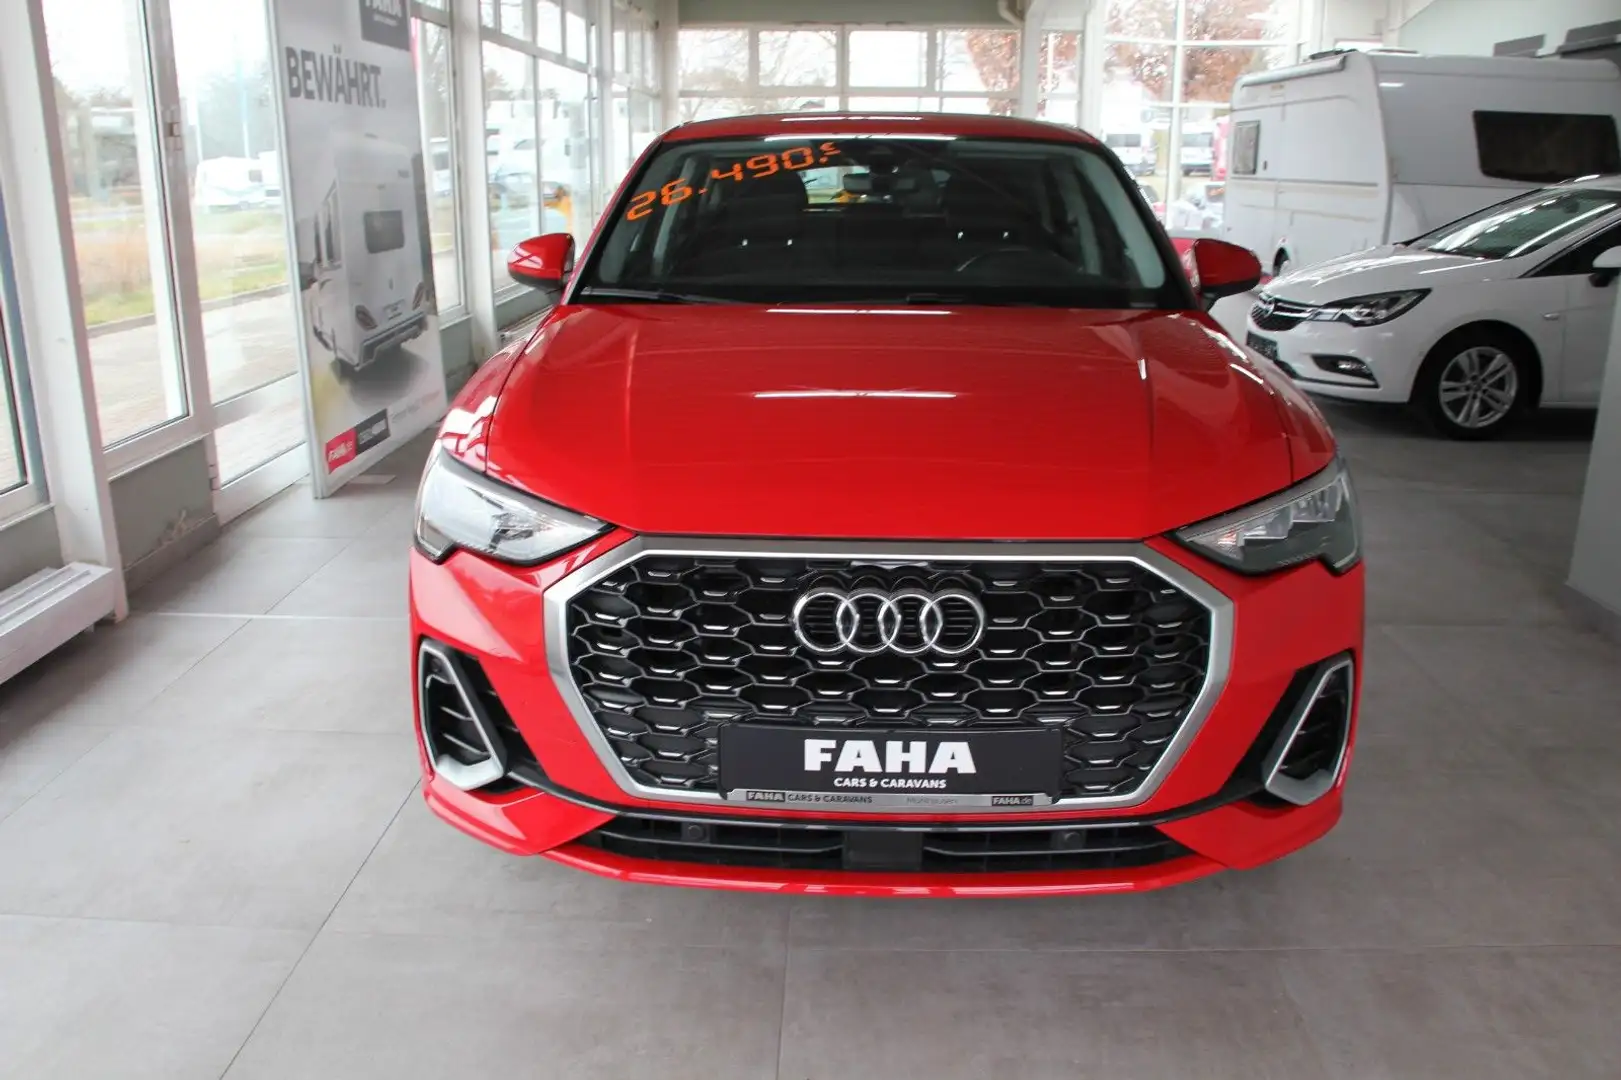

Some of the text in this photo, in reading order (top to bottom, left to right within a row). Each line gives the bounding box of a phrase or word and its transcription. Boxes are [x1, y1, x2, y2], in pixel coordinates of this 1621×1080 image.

[285, 44, 387, 109] BEWÄHRT.
[804, 739, 977, 773] FAHA
[833, 777, 947, 789] CARS & CARAVANS
[747, 791, 783, 801] FAHA
[787, 793, 813, 802] CARS
[822, 795, 873, 804] CARAVANS
